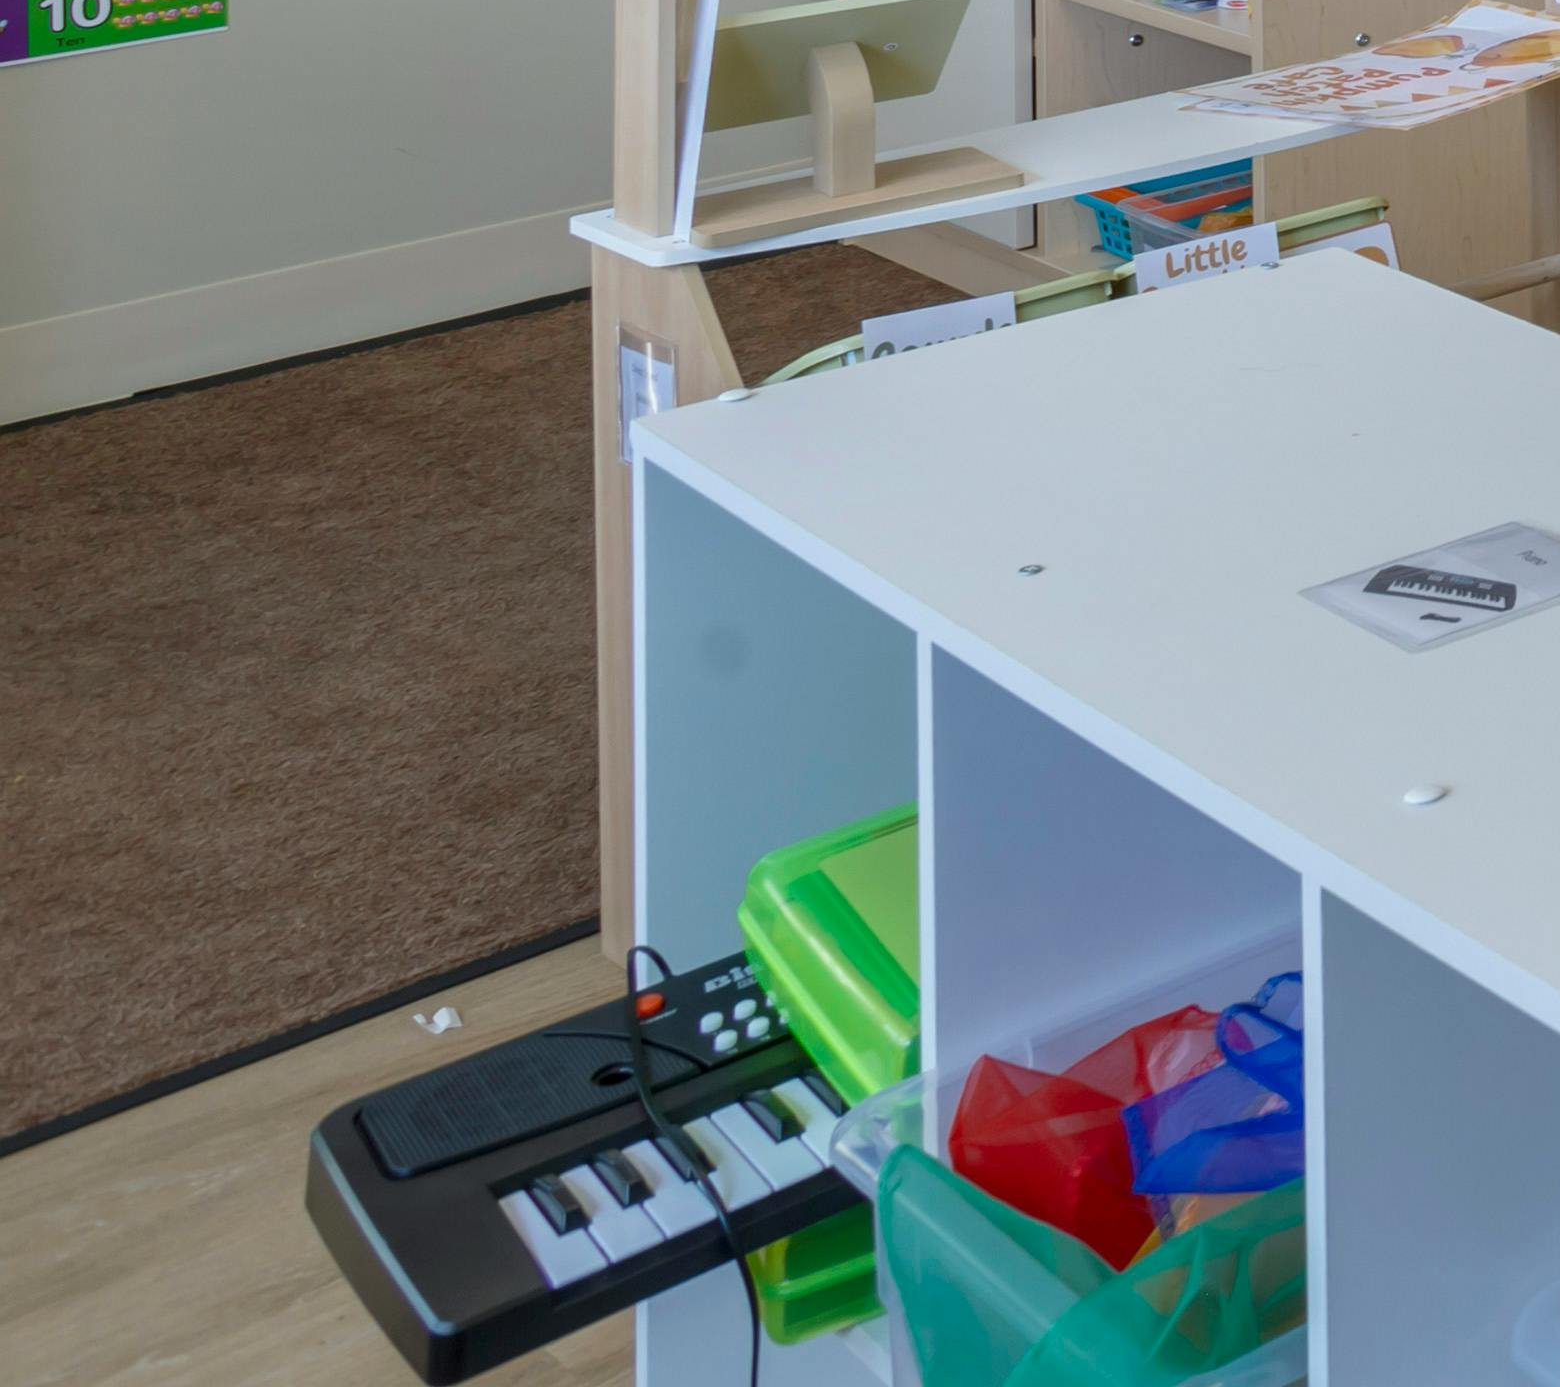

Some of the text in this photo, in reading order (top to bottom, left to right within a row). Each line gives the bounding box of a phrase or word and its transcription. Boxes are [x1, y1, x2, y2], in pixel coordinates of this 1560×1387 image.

[56, 35, 86, 49] Ten
[1259, 67, 1394, 98] Patch
[1270, 67, 1451, 108] Pumpkin
[1164, 238, 1249, 280] Little
